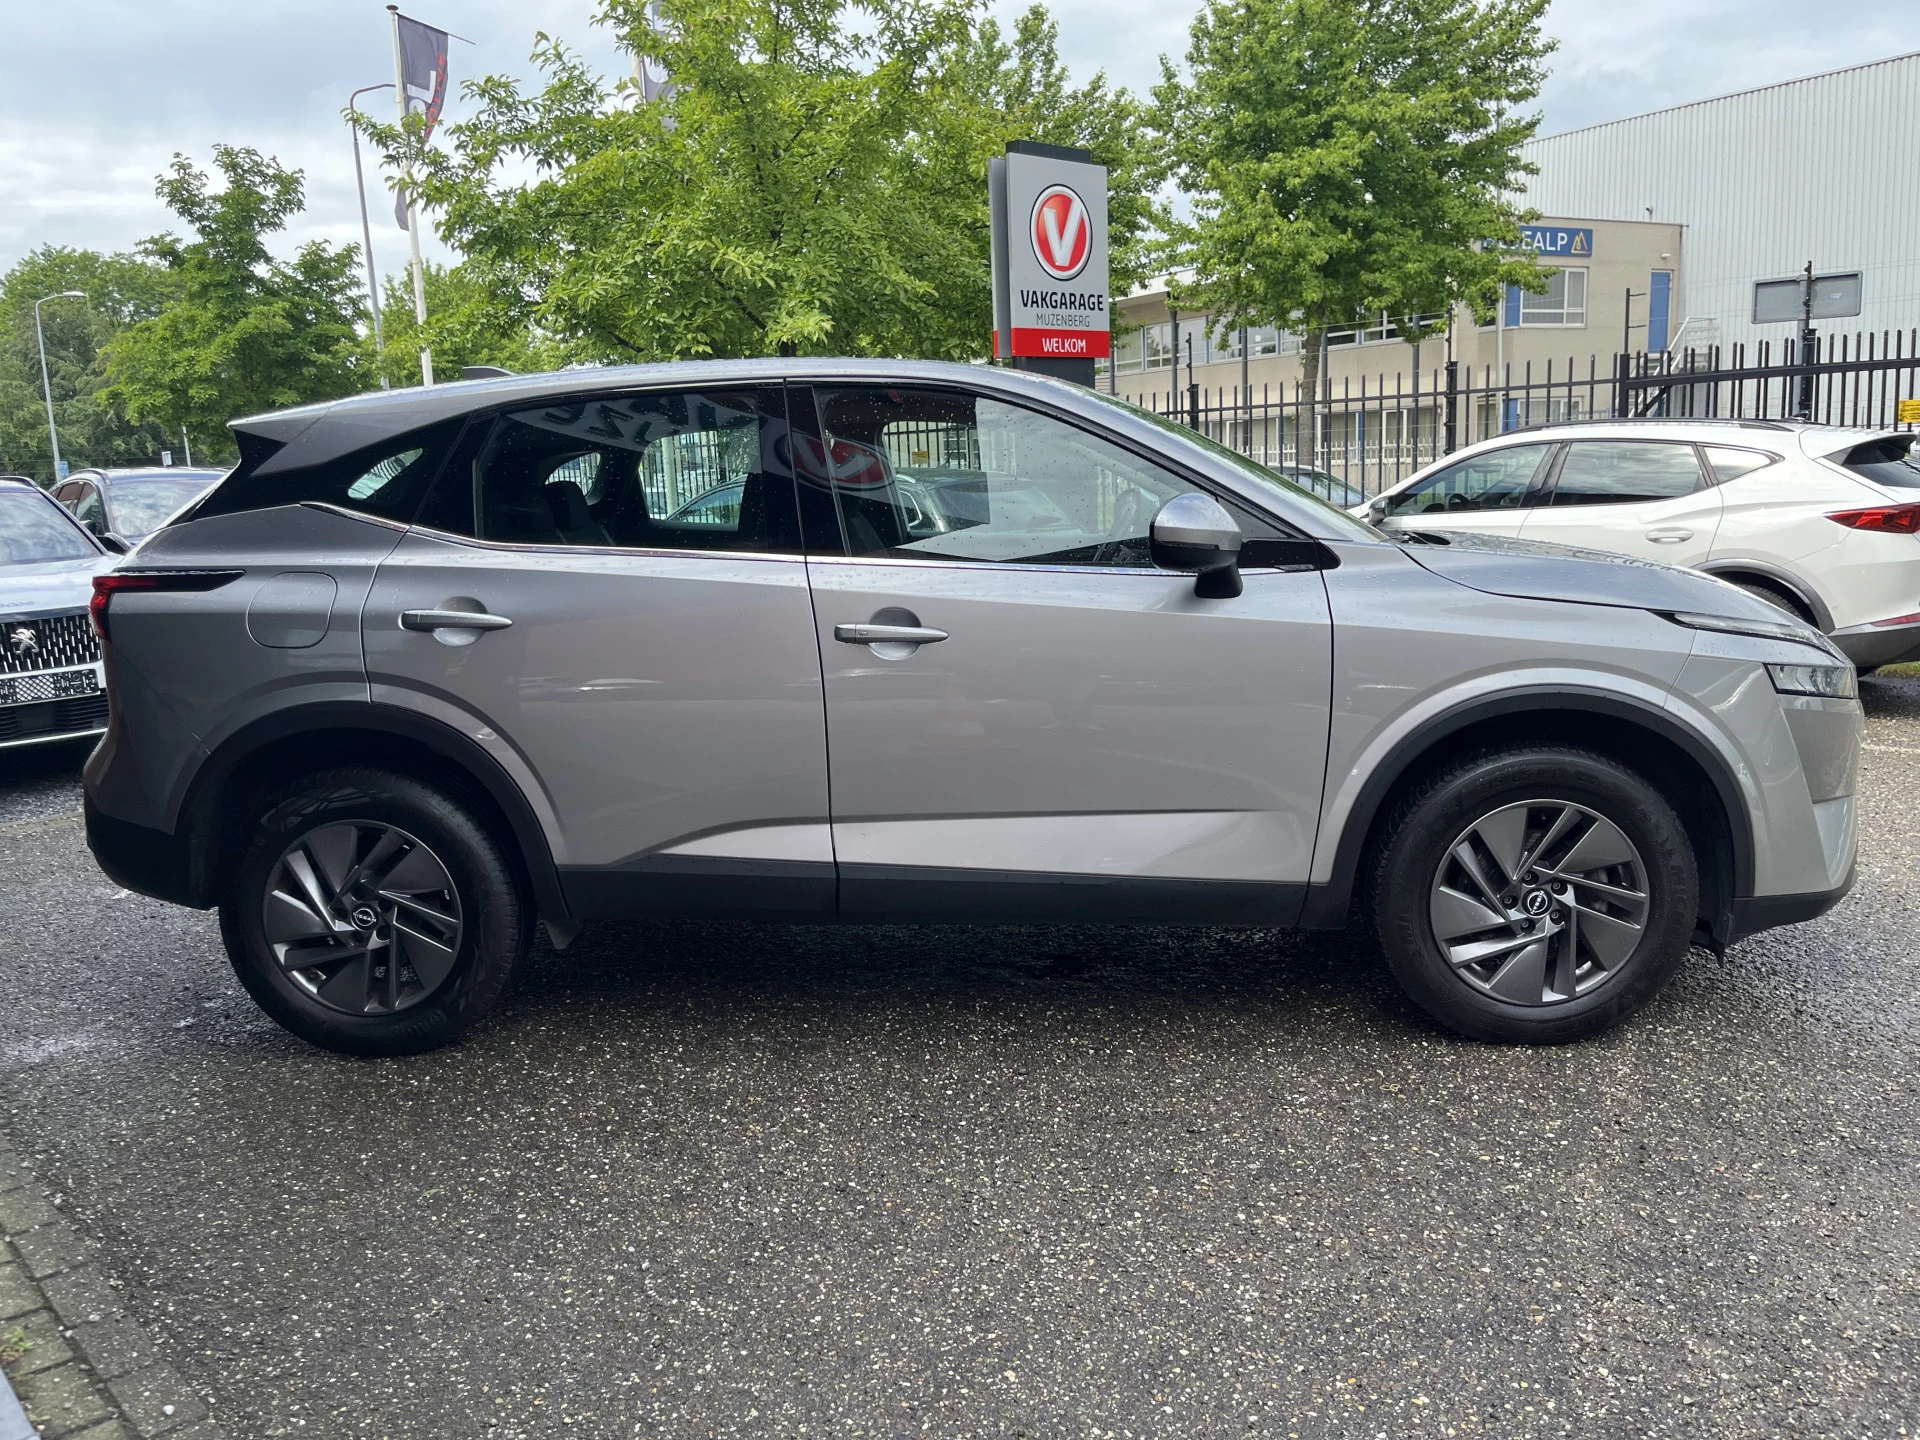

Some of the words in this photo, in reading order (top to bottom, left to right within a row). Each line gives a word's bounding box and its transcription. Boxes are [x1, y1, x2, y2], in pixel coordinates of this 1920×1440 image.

[1020, 289, 1104, 311] VAKGARAGE
[1036, 313, 1090, 328] MUZENBERG
[1042, 337, 1086, 353] WELKOM
